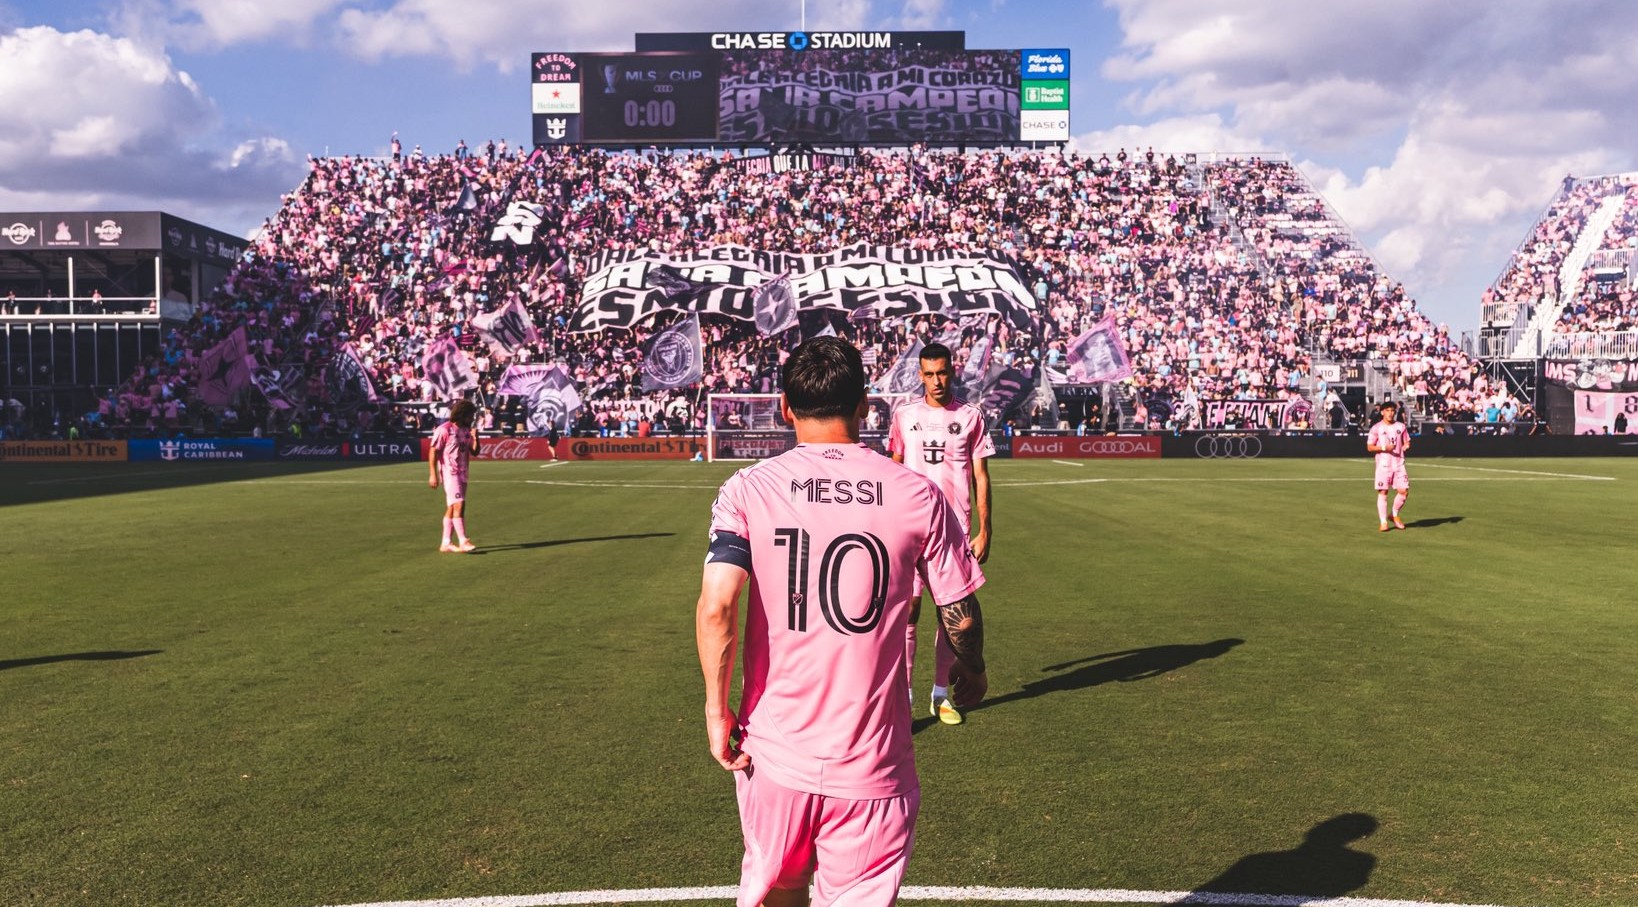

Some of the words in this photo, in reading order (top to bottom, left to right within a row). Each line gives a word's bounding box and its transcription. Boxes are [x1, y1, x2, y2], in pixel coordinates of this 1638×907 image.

[711, 33, 786, 49] CHASE
[811, 33, 891, 48] STADIUM
[535, 54, 577, 70] FREEDOM
[540, 73, 571, 81] DREAM
[625, 71, 656, 81] MLS
[670, 71, 702, 81] CUP
[624, 100, 675, 127] 0:00
[1023, 121, 1055, 129] CHASE
[86, 443, 117, 456] Tire
[280, 445, 338, 456] Michelob
[355, 445, 413, 455] ULTRA
[571, 441, 660, 456] Continental
[1019, 442, 1063, 453] Audi
[791, 478, 883, 506] MESSI
[774, 528, 890, 636] 10
